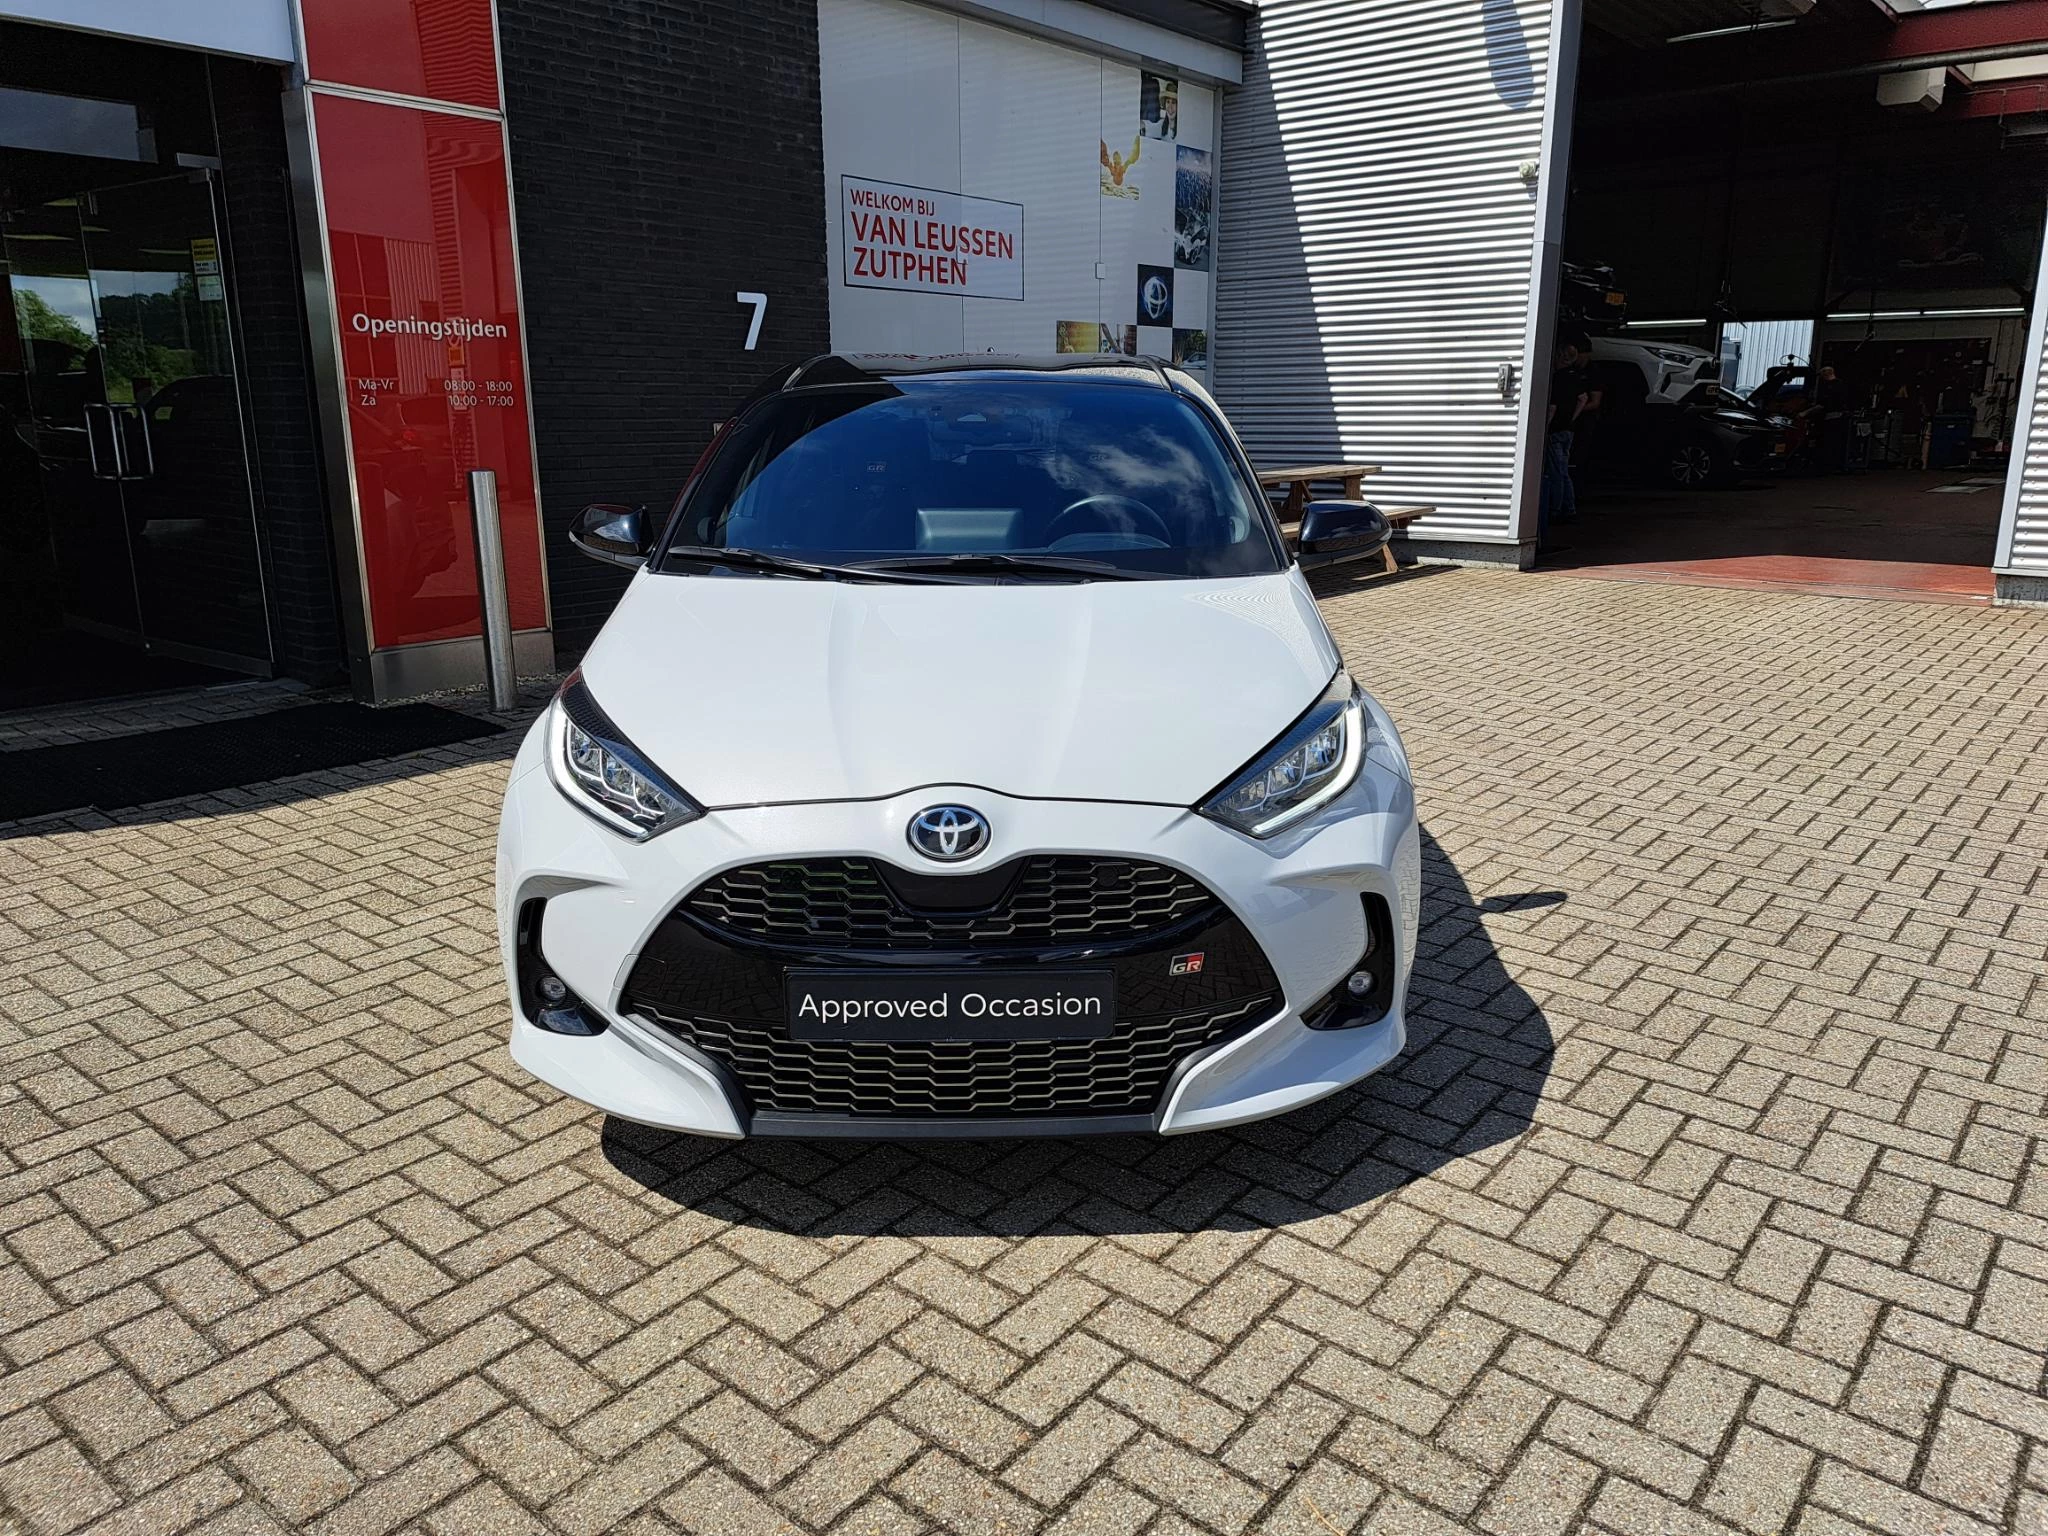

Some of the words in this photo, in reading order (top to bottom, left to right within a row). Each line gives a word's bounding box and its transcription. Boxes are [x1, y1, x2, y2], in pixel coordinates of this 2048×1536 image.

[850, 188, 913, 214] WELKOM
[917, 199, 935, 217] BIJ
[851, 211, 906, 247] VAN
[914, 220, 1013, 260] LEUSSEN
[853, 246, 967, 286] ZUTPHEN
[352, 313, 508, 342] Openingstijden
[736, 291, 768, 350] 7
[358, 378, 394, 391] Ma-Vr
[444, 379, 476, 392] 08:00
[486, 380, 513, 393] 18:00
[361, 394, 377, 407] Za
[449, 395, 478, 407] 10:00
[488, 395, 514, 407] 17:00
[1172, 960, 1201, 974] GR
[798, 993, 949, 1024] Approved
[960, 991, 1102, 1017] Occasion
